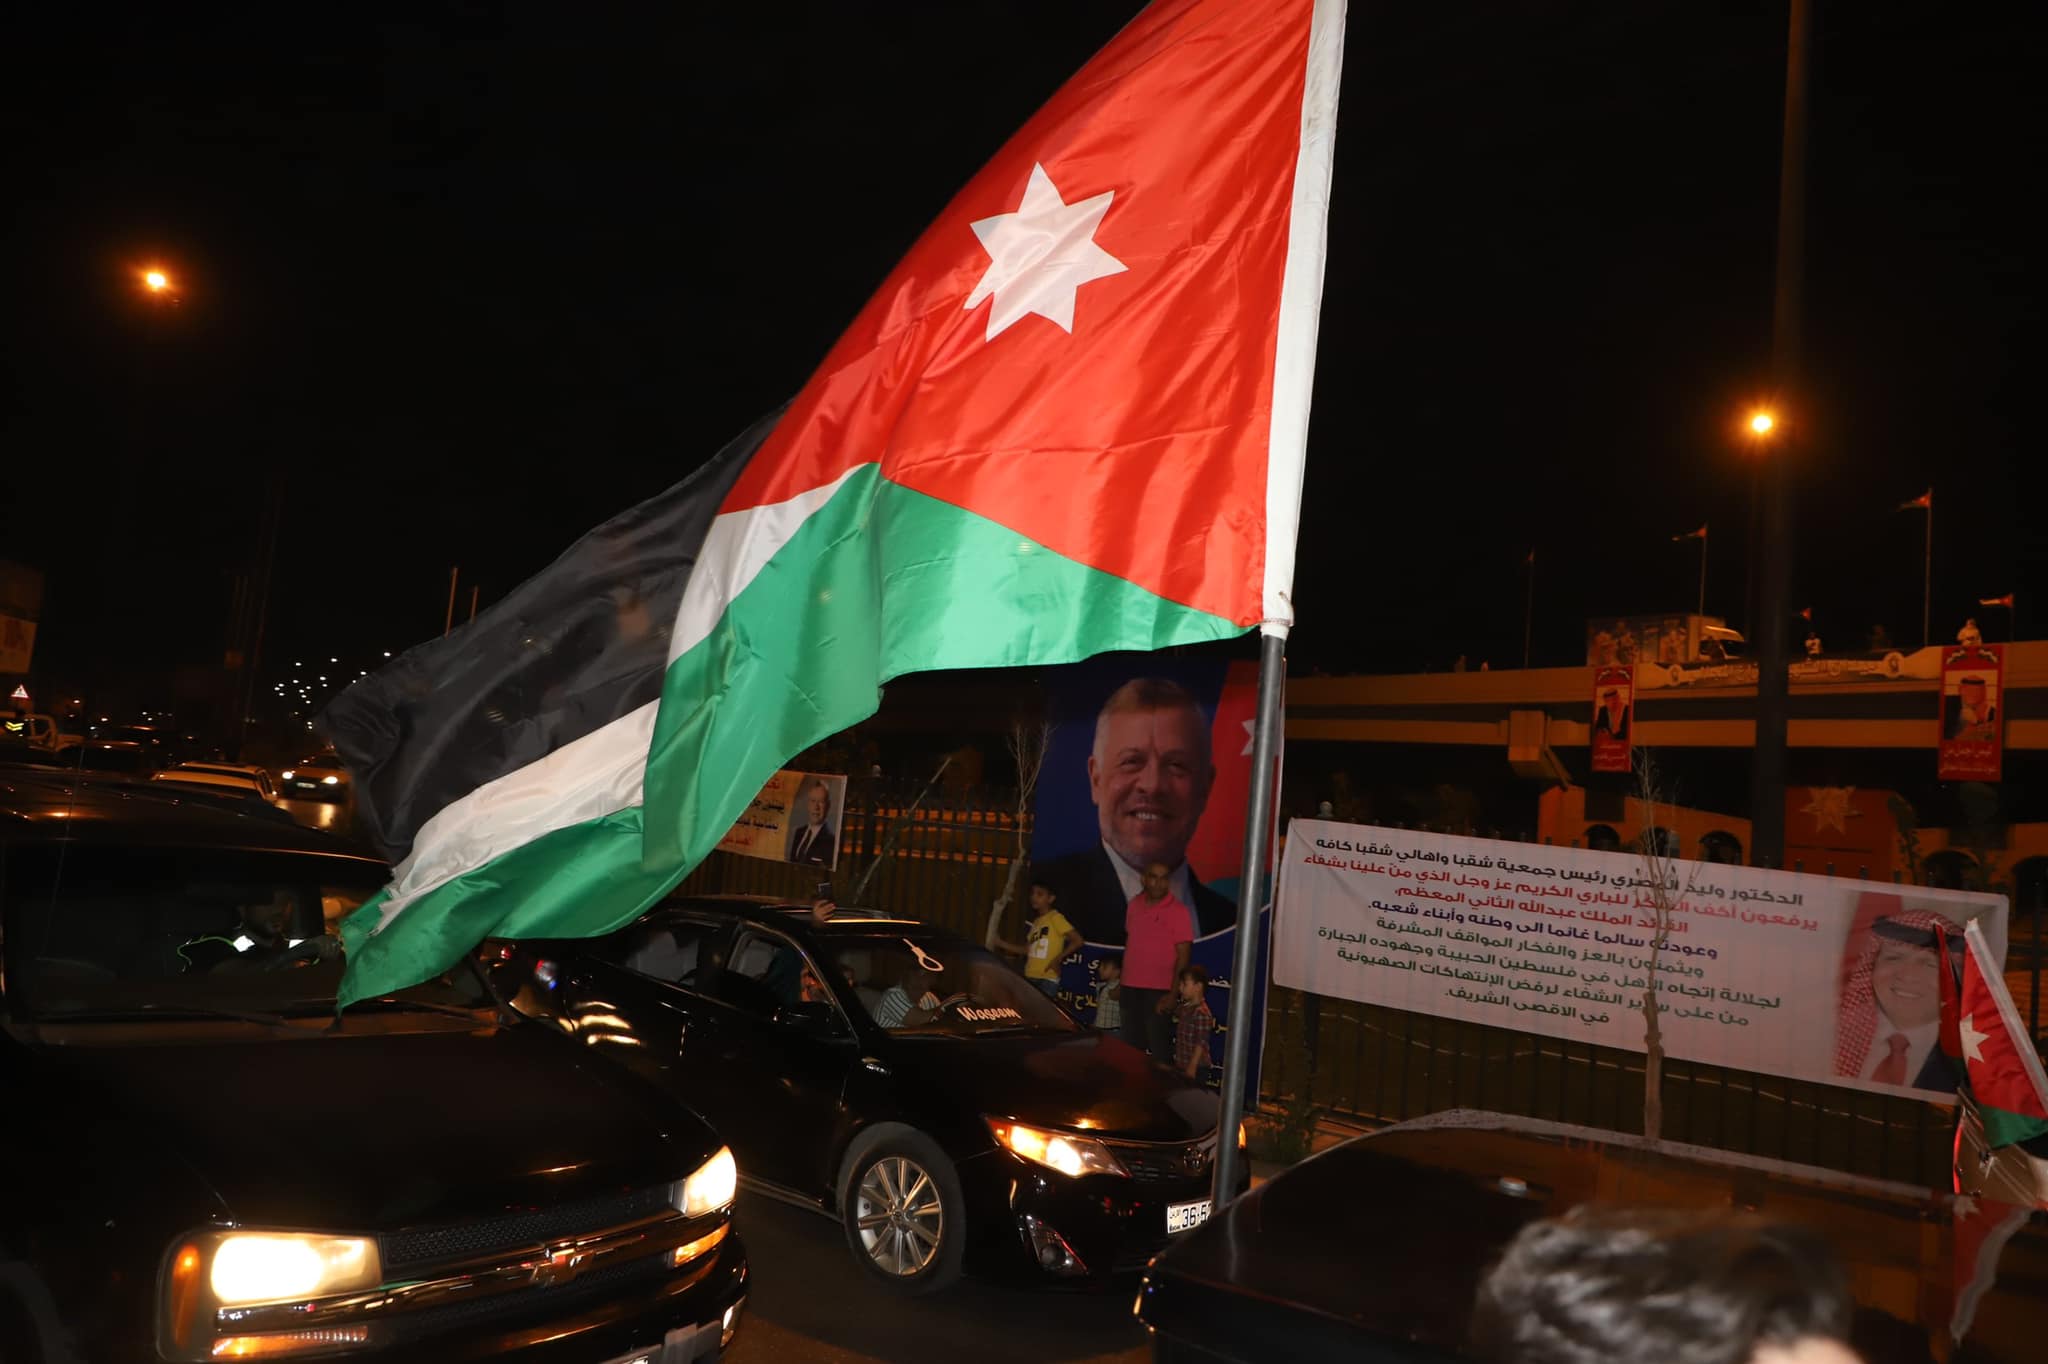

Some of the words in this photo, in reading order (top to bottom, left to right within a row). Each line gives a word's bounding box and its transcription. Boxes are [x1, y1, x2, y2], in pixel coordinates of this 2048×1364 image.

[1356, 842, 1393, 856] شقبا
[1303, 853, 1348, 870] بشفاء
[1350, 860, 1385, 875] علينا
[1453, 854, 1493, 869] شقبا
[1497, 858, 1556, 877] جمعية
[1415, 868, 1450, 884] الذي
[1453, 874, 1490, 890] وجل
[1494, 875, 1512, 892] عز
[1560, 868, 1607, 885] رئيس
[1515, 882, 1573, 899] الكريم
[1577, 889, 1629, 905] للباري
[1686, 881, 1725, 899] وليد
[1730, 888, 1803, 905] الدكتور
[1468, 893, 1514, 911] الثاني
[1518, 900, 1577, 919] عبدالله
[1693, 903, 1737, 919] أكف
[1376, 916, 1443, 938] المشرفة
[1468, 912, 1513, 931] وطنه
[1580, 910, 1632, 926] الملك
[1741, 911, 1819, 932] يرفعون
[1318, 926, 1367, 945] الجبارة
[1516, 922, 1544, 934] الى
[1547, 924, 1590, 940] غانما
[1370, 937, 1434, 957] وجهوده
[1447, 928, 1513, 948] المواقف
[1594, 930, 1645, 948] سالما
[1437, 946, 1495, 965] الحبيبة
[1516, 939, 1577, 960] والفخار
[1581, 948, 1625, 966] بالعز
[1648, 936, 1718, 960] وعودته
[1337, 946, 1417, 972] الصهيونية
[1499, 956, 1577, 978] فلسطين
[1628, 956, 1704, 978] ويثمنون
[1507, 980, 1559, 996] لرفض
[1581, 973, 1610, 986] في
[1614, 974, 1663, 991] الهل
[1562, 987, 1623, 1005] الشفاء
[1627, 995, 1670, 1013] سير
[1719, 987, 1781, 1009] لجلالة
[1513, 998, 1576, 1018] الاقصى
[1674, 1006, 1715, 1021] على
[1580, 1012, 1610, 1026] في
[1718, 1009, 1749, 1026] من
